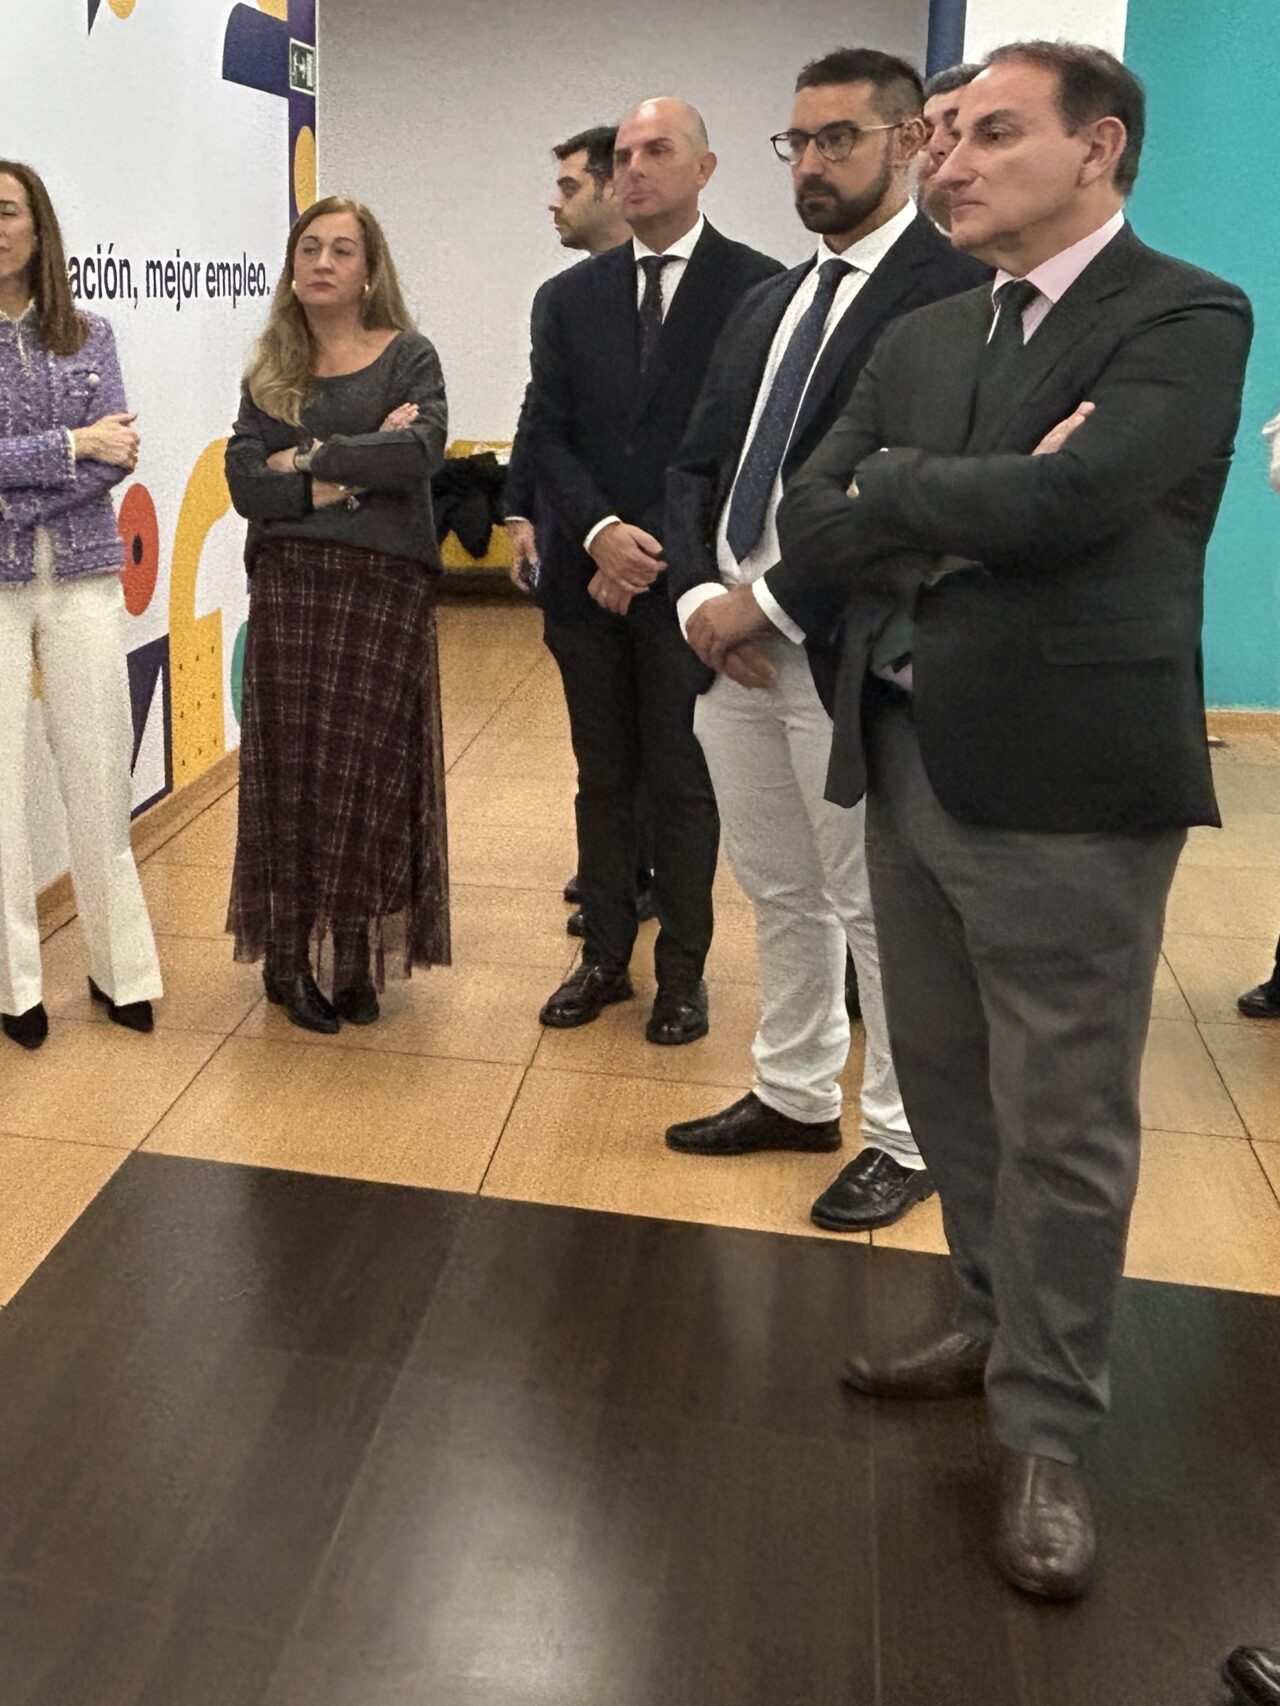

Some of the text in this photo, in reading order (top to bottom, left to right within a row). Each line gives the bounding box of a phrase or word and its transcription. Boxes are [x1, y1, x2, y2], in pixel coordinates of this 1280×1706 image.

[68, 243, 270, 311] ación, mejor empleo.
